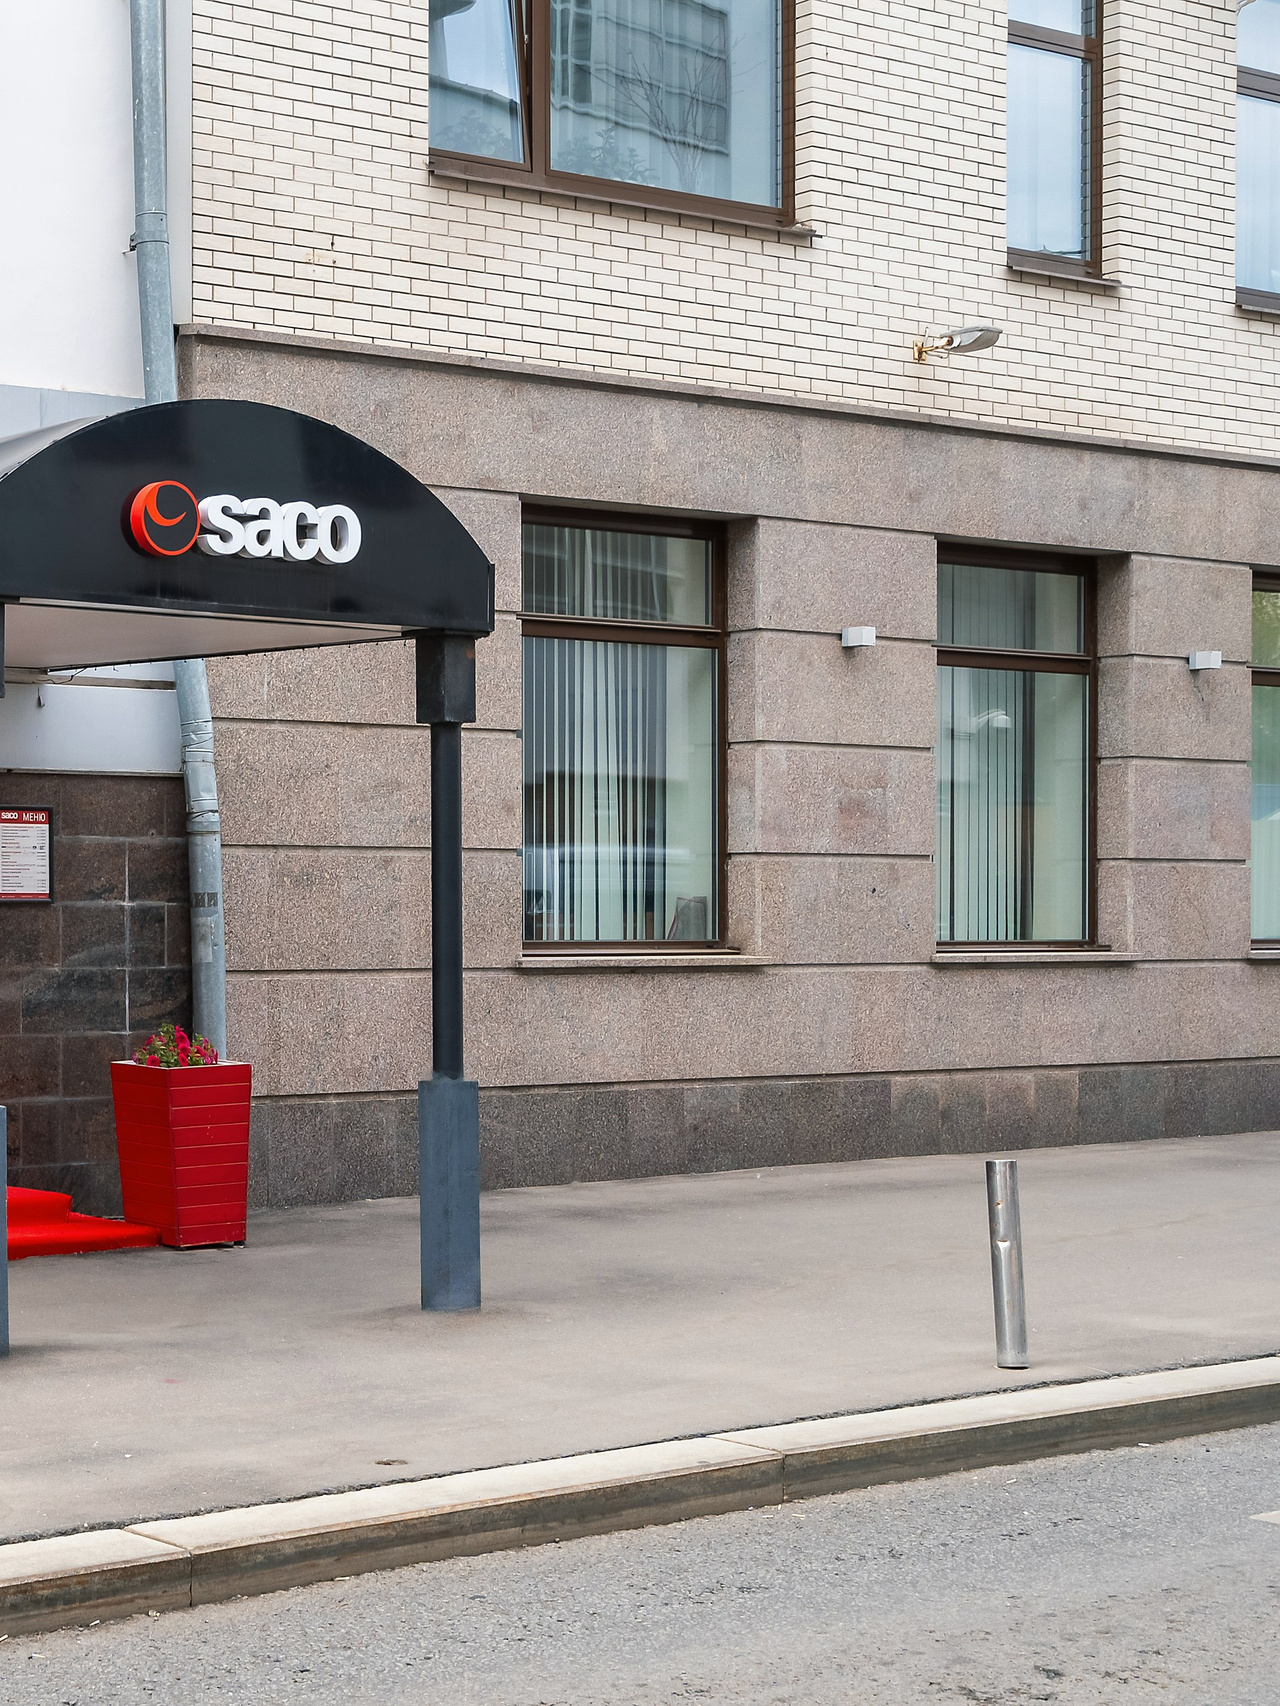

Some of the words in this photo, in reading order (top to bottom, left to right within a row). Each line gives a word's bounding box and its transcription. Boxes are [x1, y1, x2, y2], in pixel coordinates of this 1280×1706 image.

[196, 494, 362, 565] saco
[1, 812, 19, 820] saco
[23, 812, 46, 822] МЕНЮ
